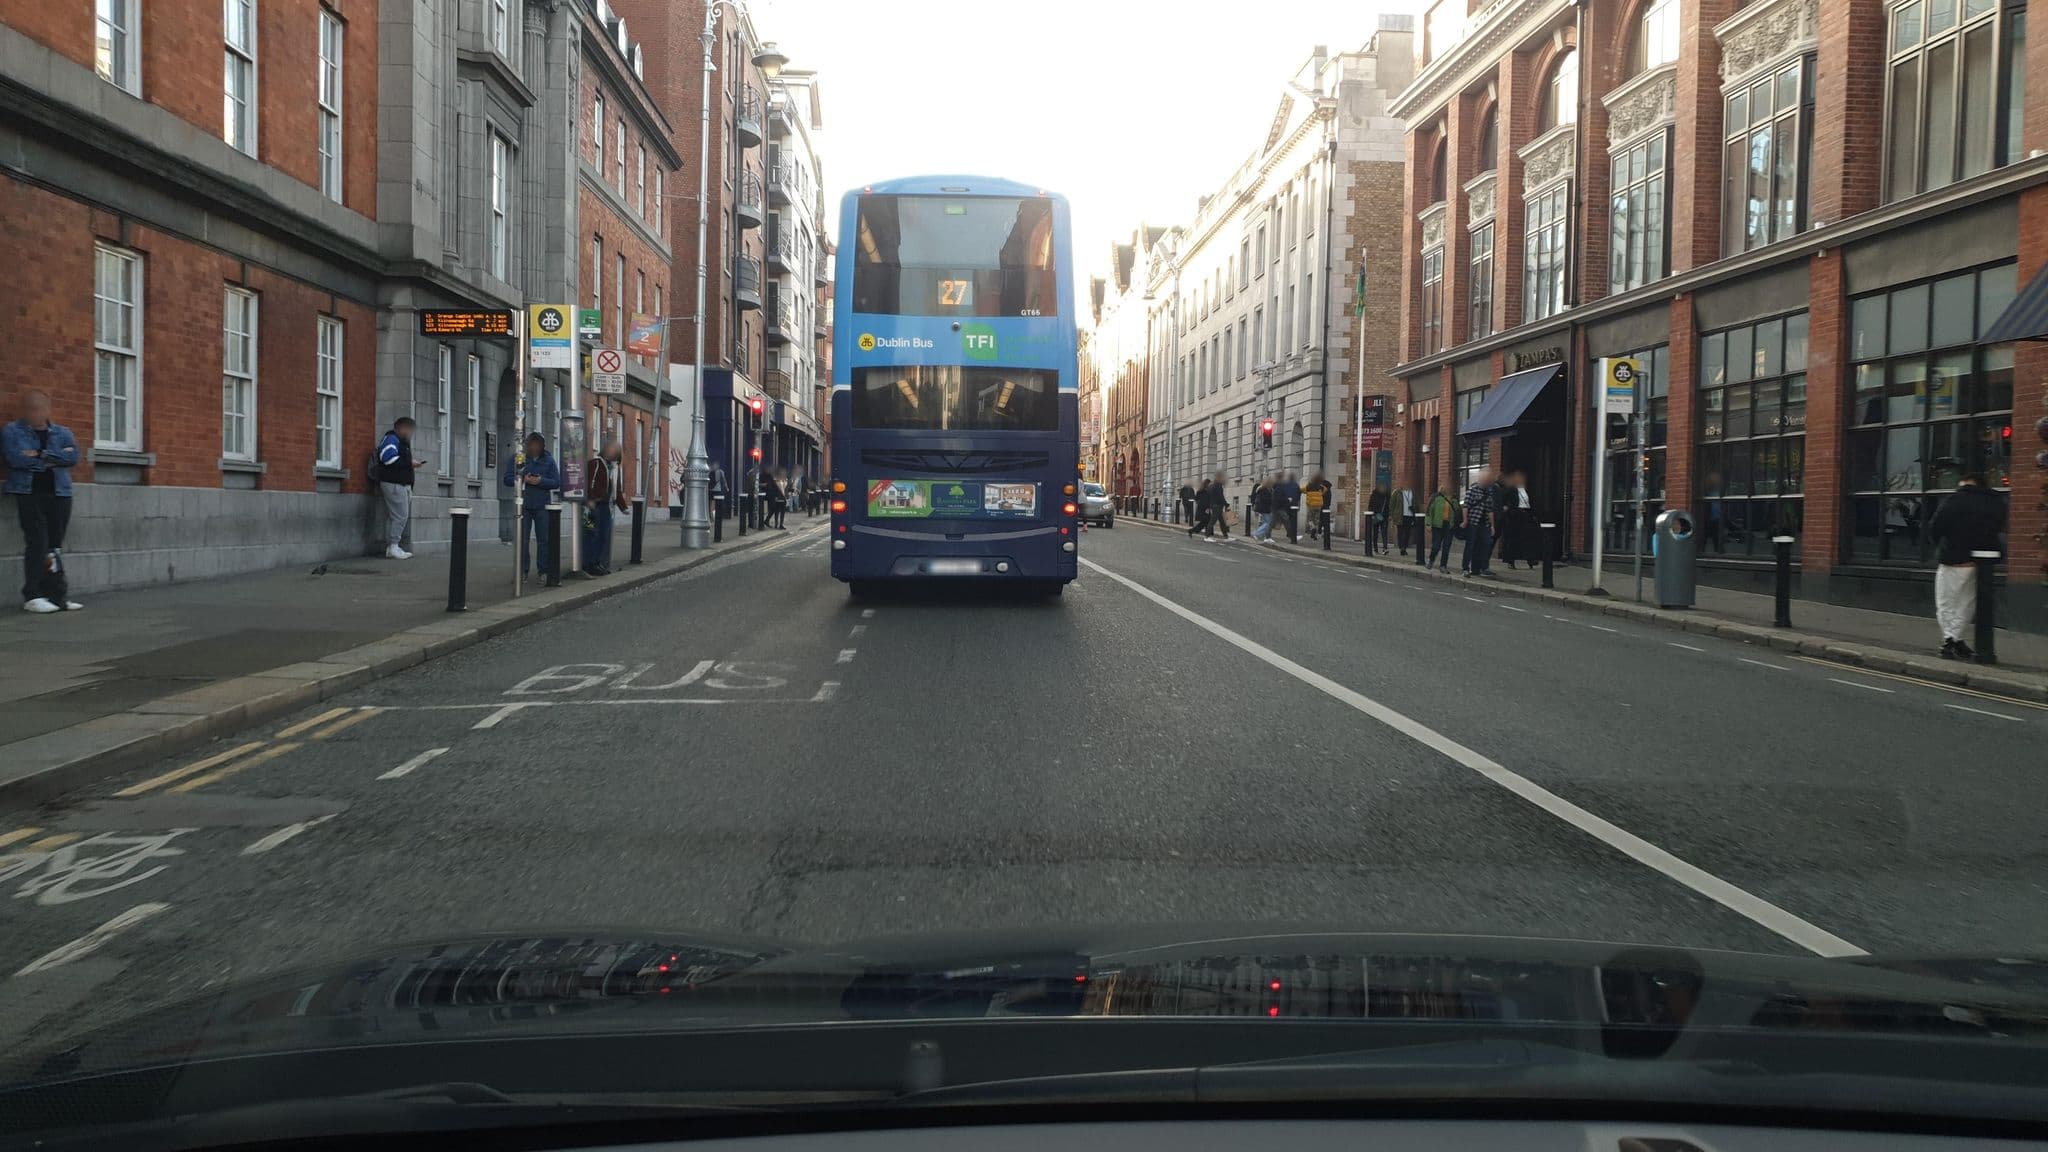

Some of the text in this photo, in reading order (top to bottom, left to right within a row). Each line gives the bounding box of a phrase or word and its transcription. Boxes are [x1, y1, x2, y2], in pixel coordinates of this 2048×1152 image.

[942, 280, 968, 304] 27
[640, 331, 650, 342] 2
[877, 337, 934, 348] Dublin Bus
[966, 334, 994, 349] TFI
[501, 659, 797, 696] BUS
